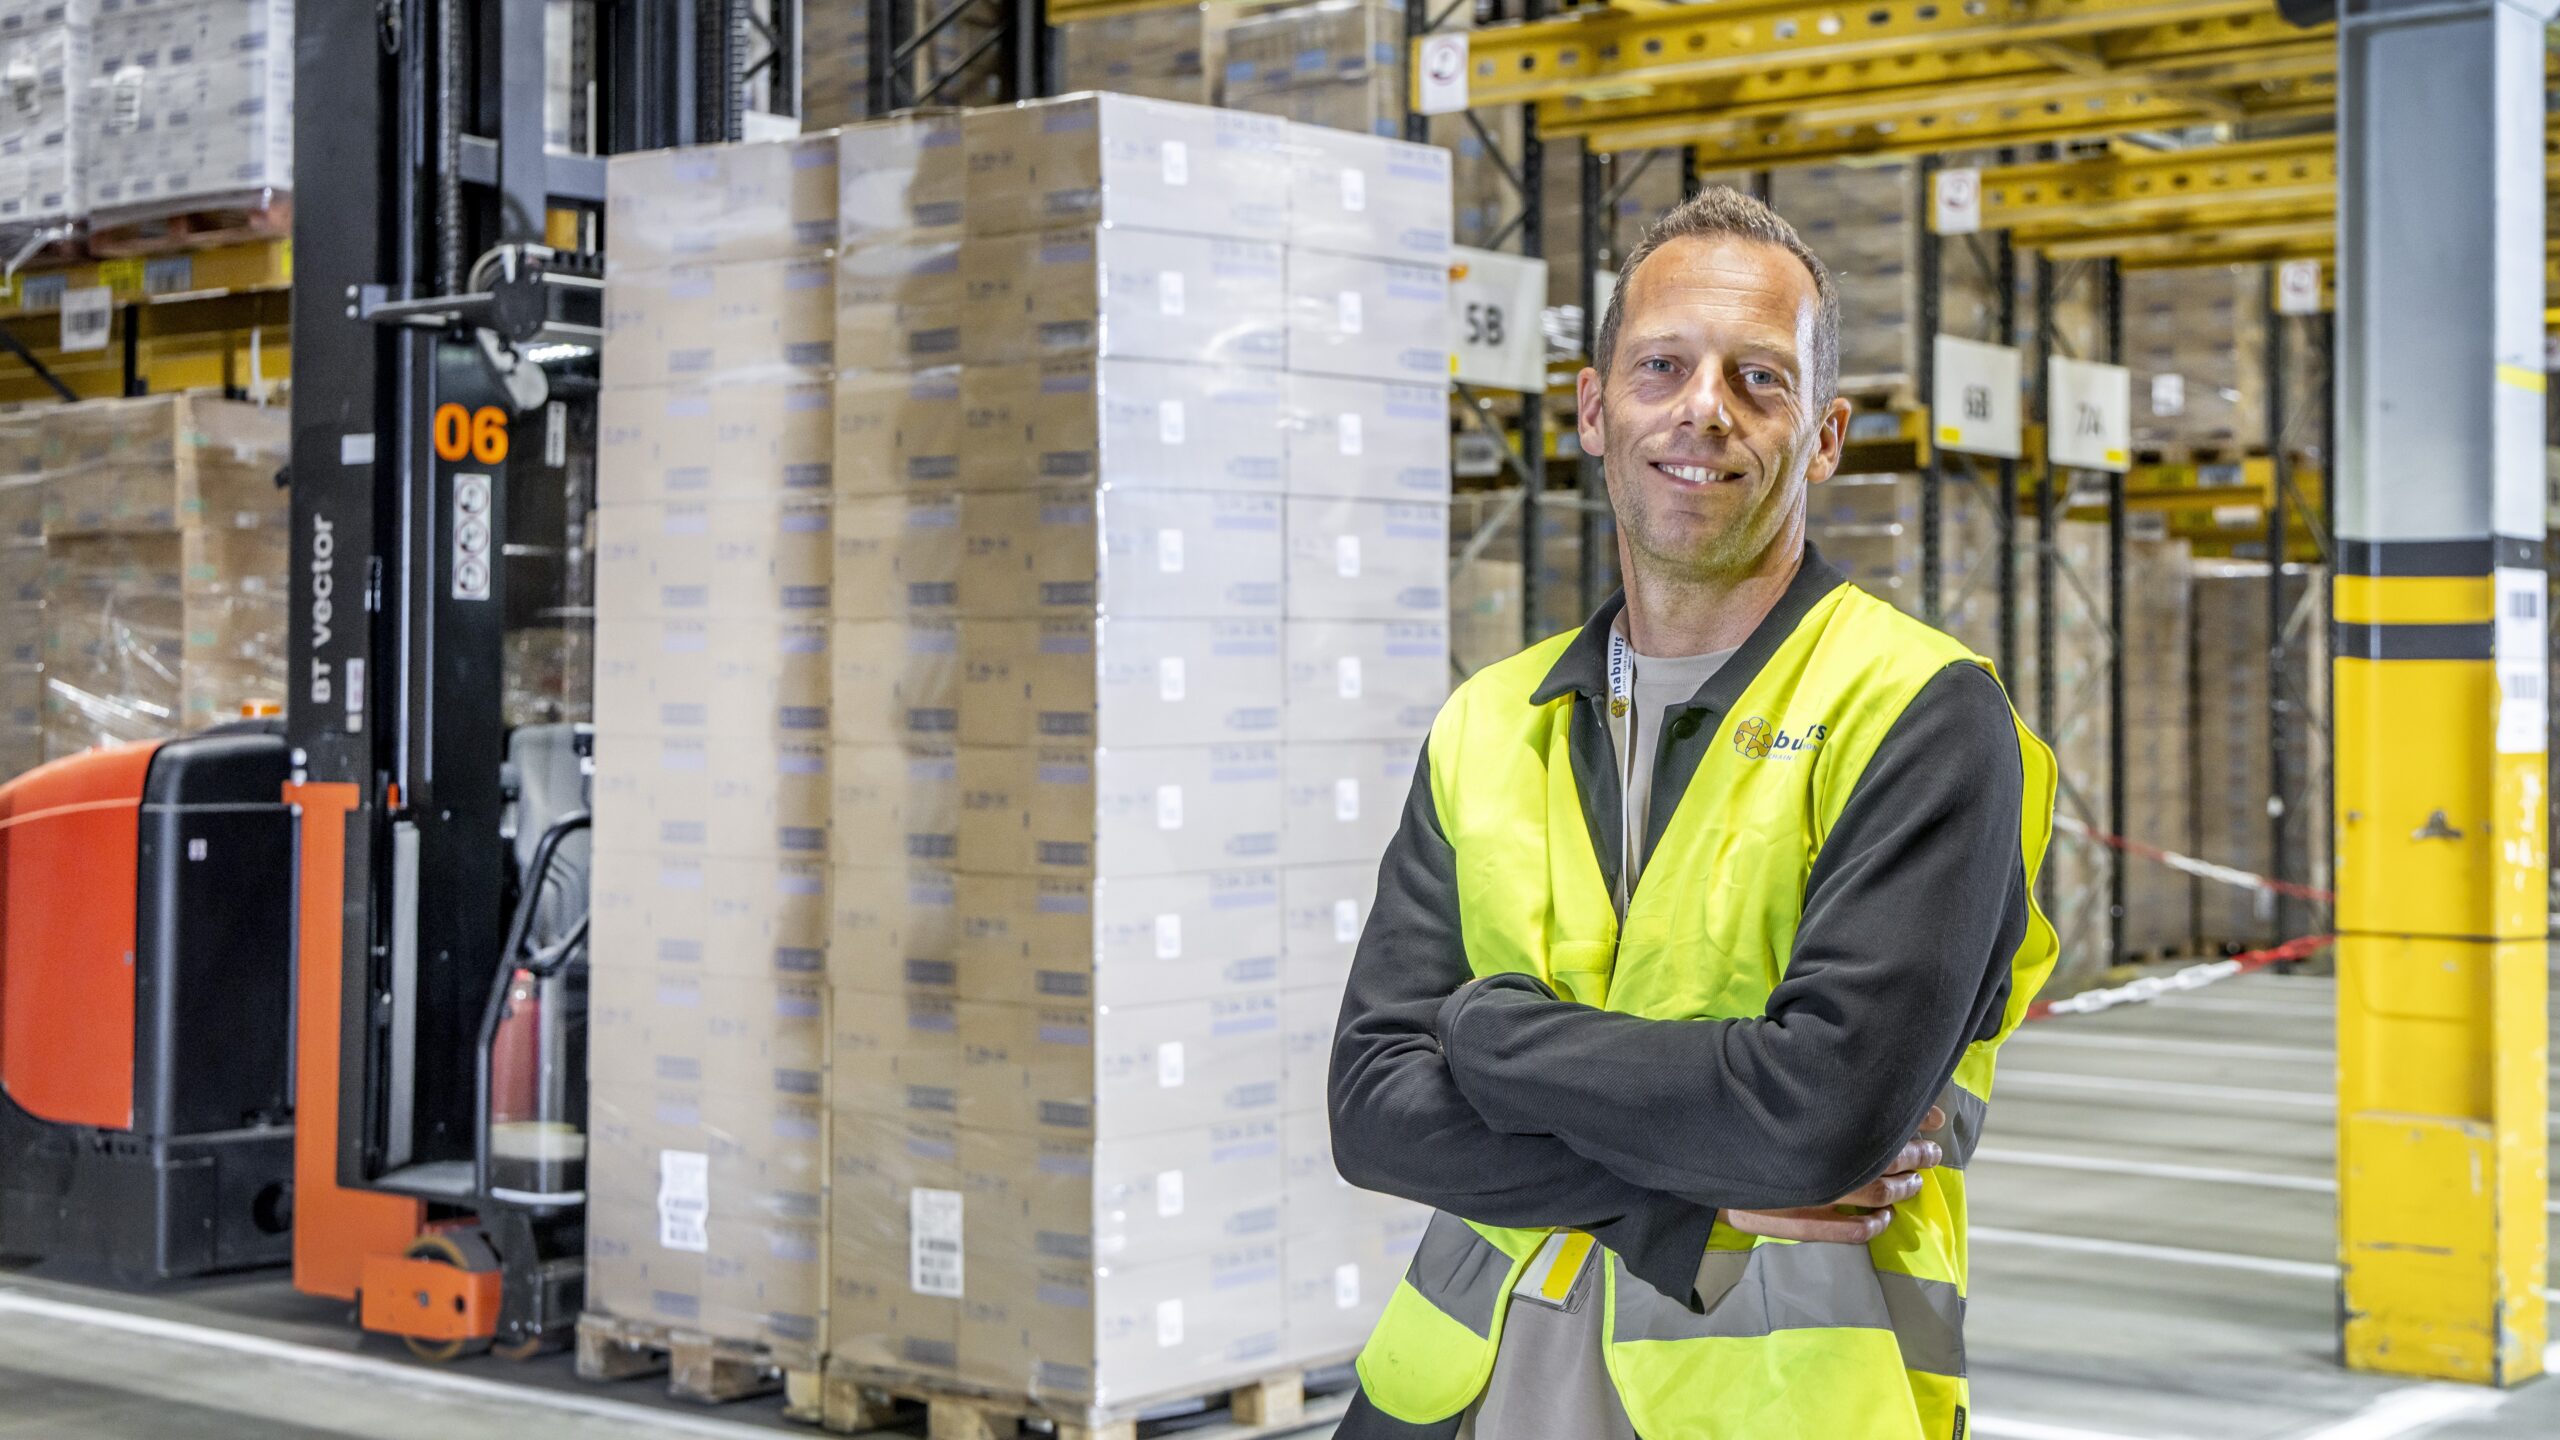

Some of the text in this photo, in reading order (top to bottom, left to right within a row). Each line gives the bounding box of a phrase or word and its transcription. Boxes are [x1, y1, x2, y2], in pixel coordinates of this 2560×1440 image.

[433, 402, 508, 465] 06
[312, 512, 333, 704] BT vector
[1610, 636, 1624, 694] nabuurs
